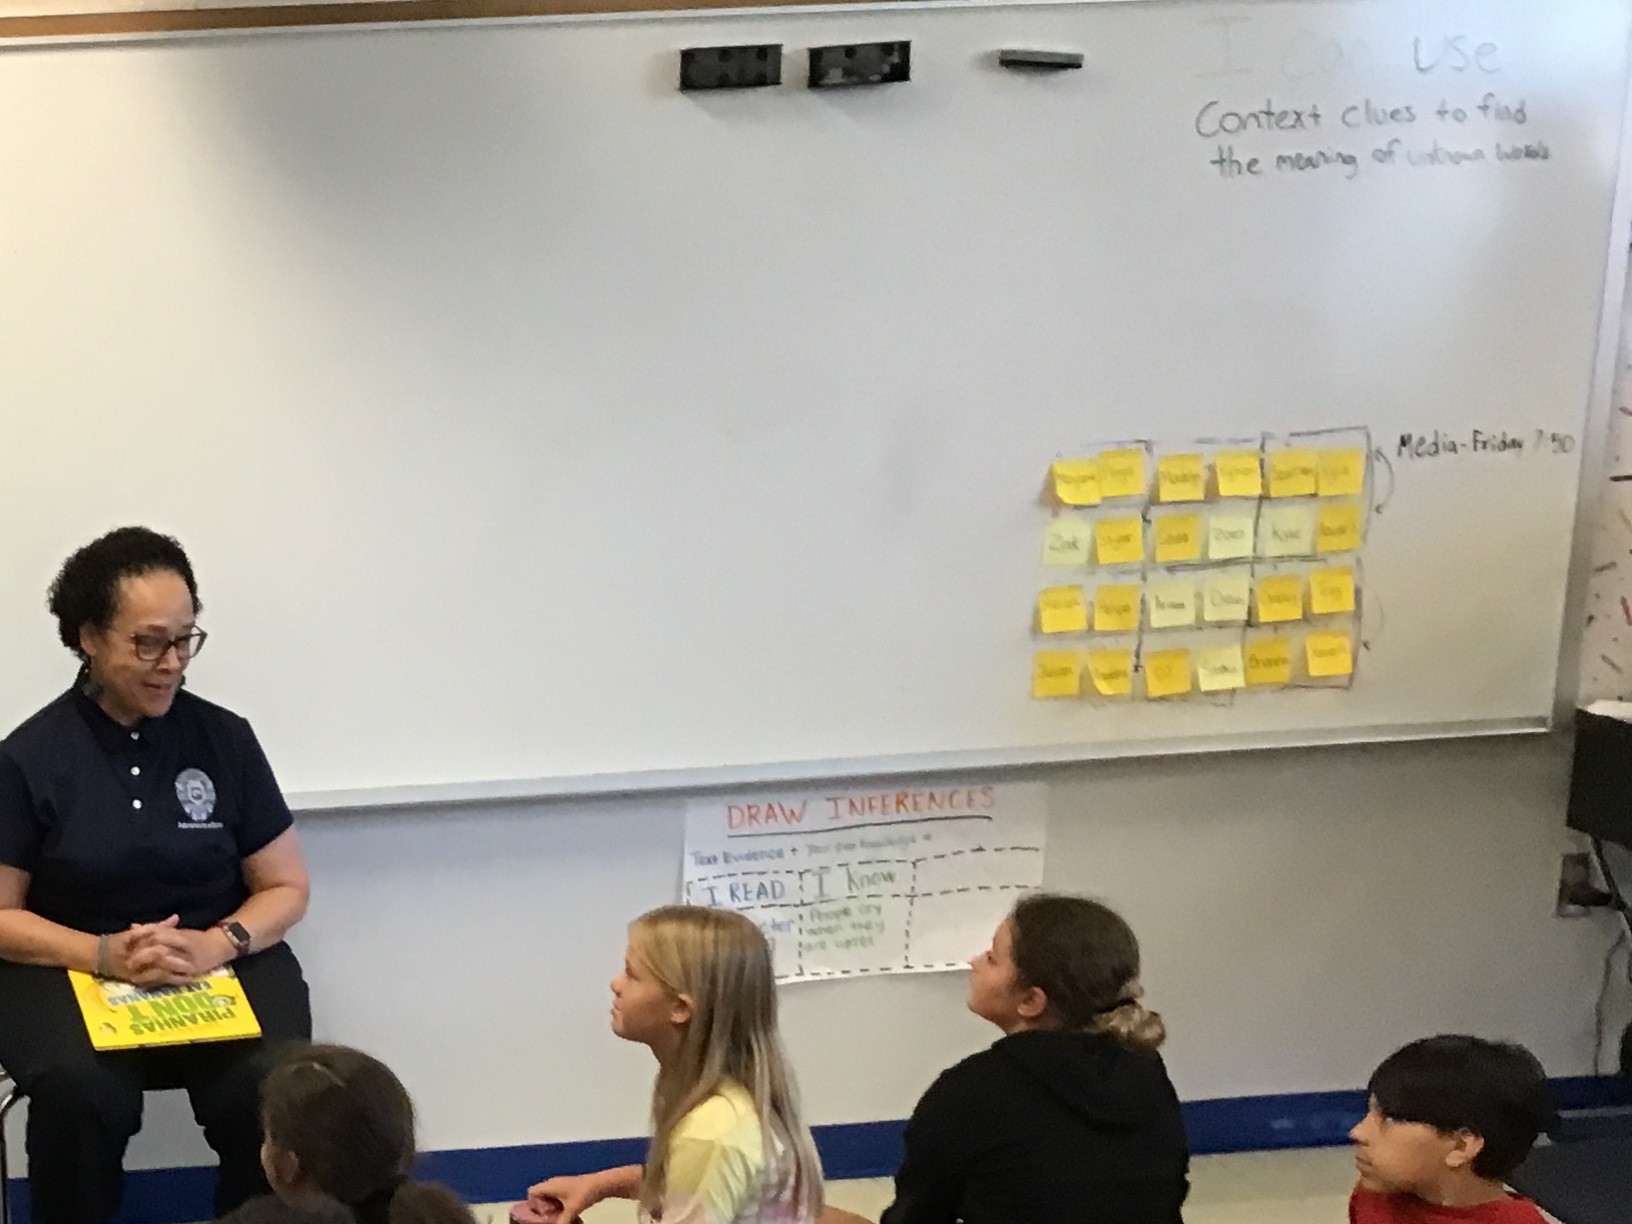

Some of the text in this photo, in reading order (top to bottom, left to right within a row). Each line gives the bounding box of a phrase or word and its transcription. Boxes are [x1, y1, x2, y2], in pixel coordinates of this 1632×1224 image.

[1195, 99, 1321, 138] Context
[1436, 99, 1467, 124] to
[1478, 92, 1528, 125] find
[1209, 146, 1262, 178] the
[1276, 147, 1358, 180] meaning
[1372, 138, 1402, 164] of
[727, 787, 996, 830] DRAW INFERENCES
[729, 879, 786, 903] READ
[131, 1007, 236, 1035] PIRANHAS
